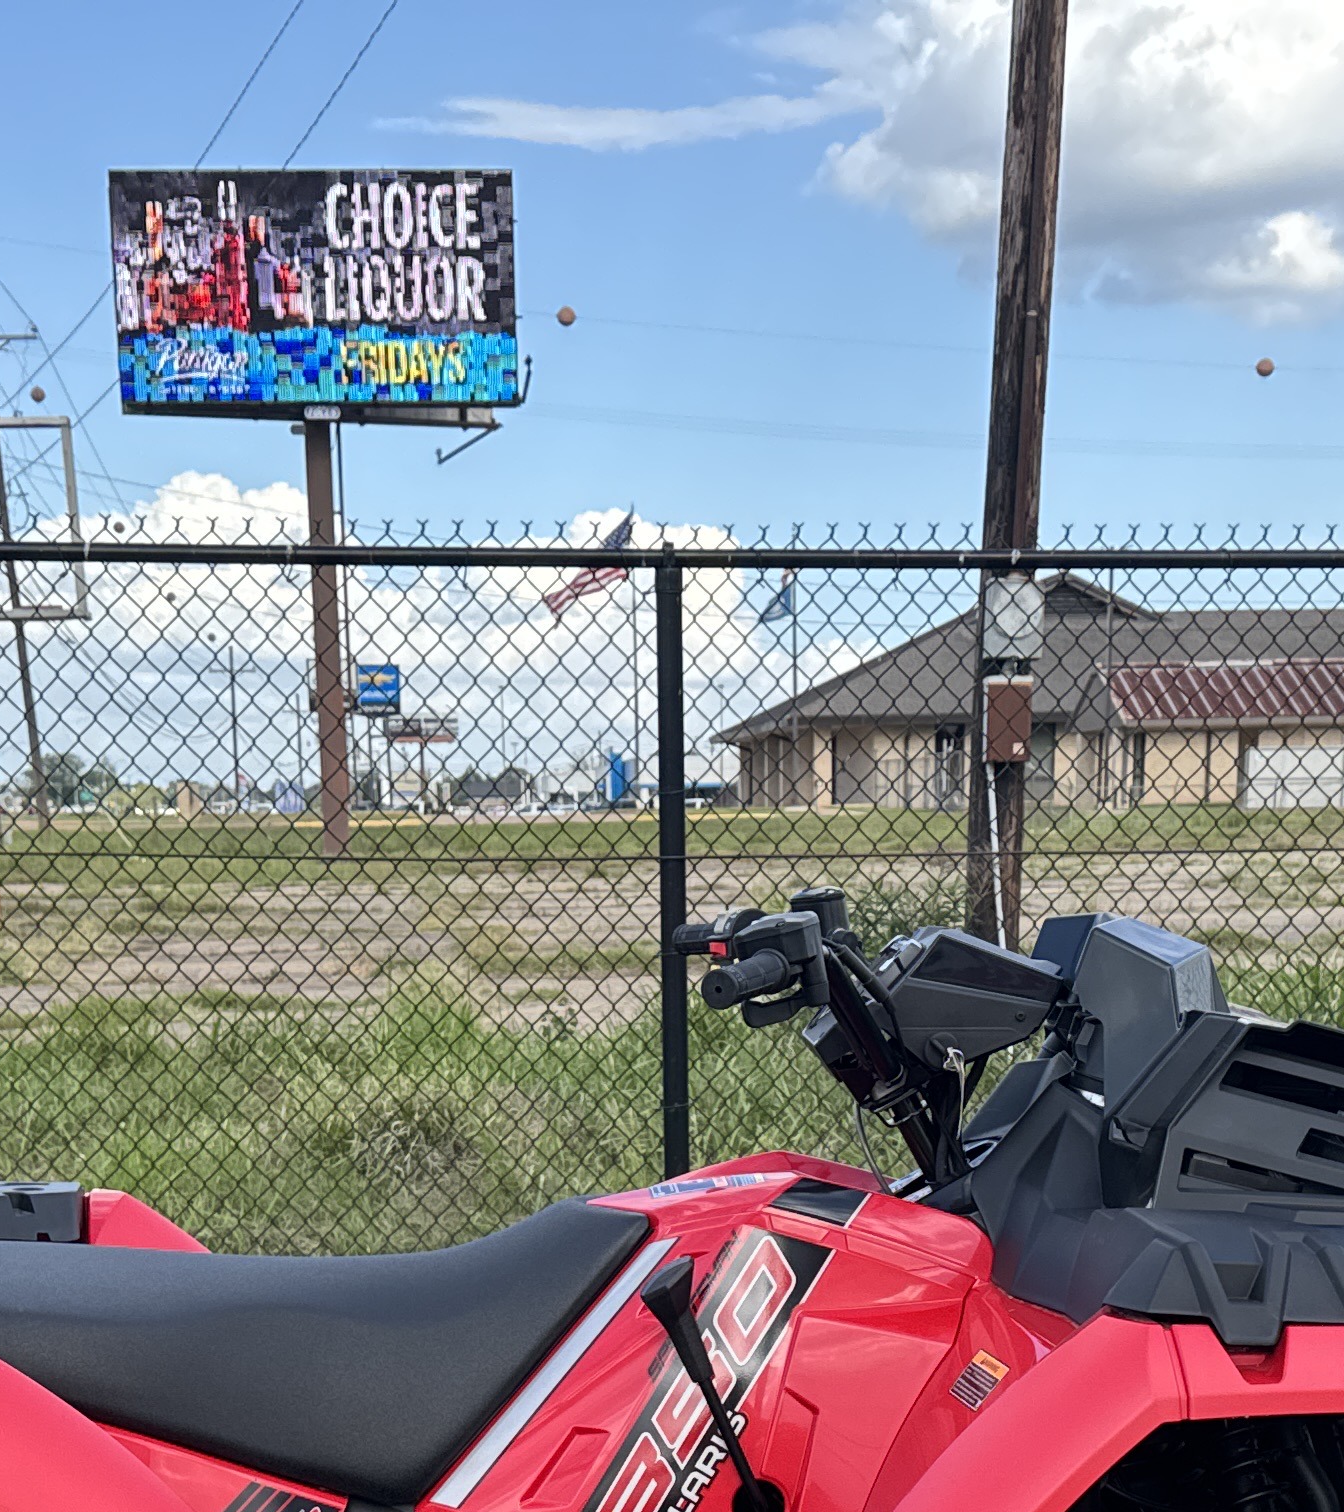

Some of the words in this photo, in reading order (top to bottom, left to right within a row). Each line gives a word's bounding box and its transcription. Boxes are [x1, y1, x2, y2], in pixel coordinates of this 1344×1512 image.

[325, 182, 481, 249] CHOICE
[324, 255, 487, 322] LIQUOR
[340, 339, 466, 384] FRIDAYS
